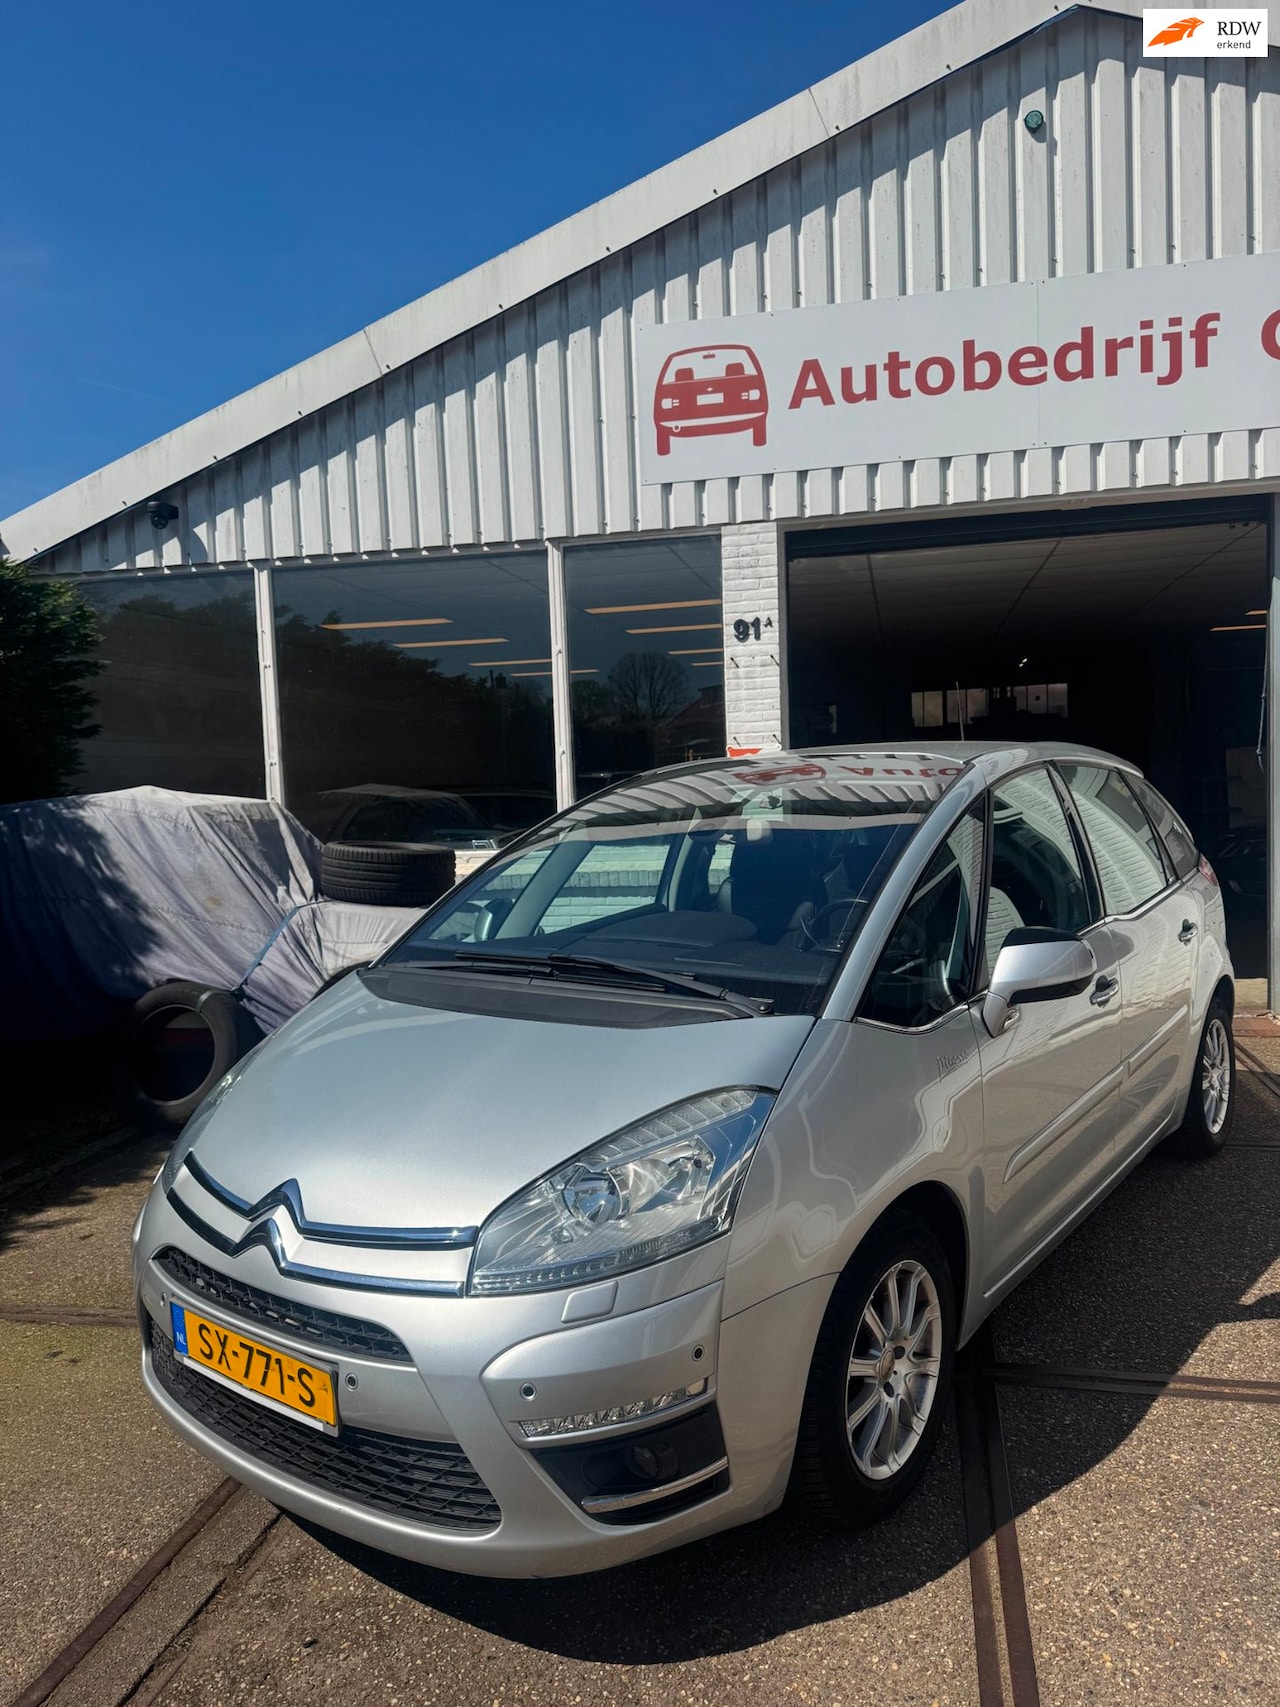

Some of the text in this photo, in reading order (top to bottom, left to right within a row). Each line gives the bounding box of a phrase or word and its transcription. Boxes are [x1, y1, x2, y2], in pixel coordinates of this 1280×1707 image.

[788, 312, 1221, 410] Autobedrijf
[176, 1331, 187, 1346] NL
[198, 1323, 316, 1408] SX-771-S
